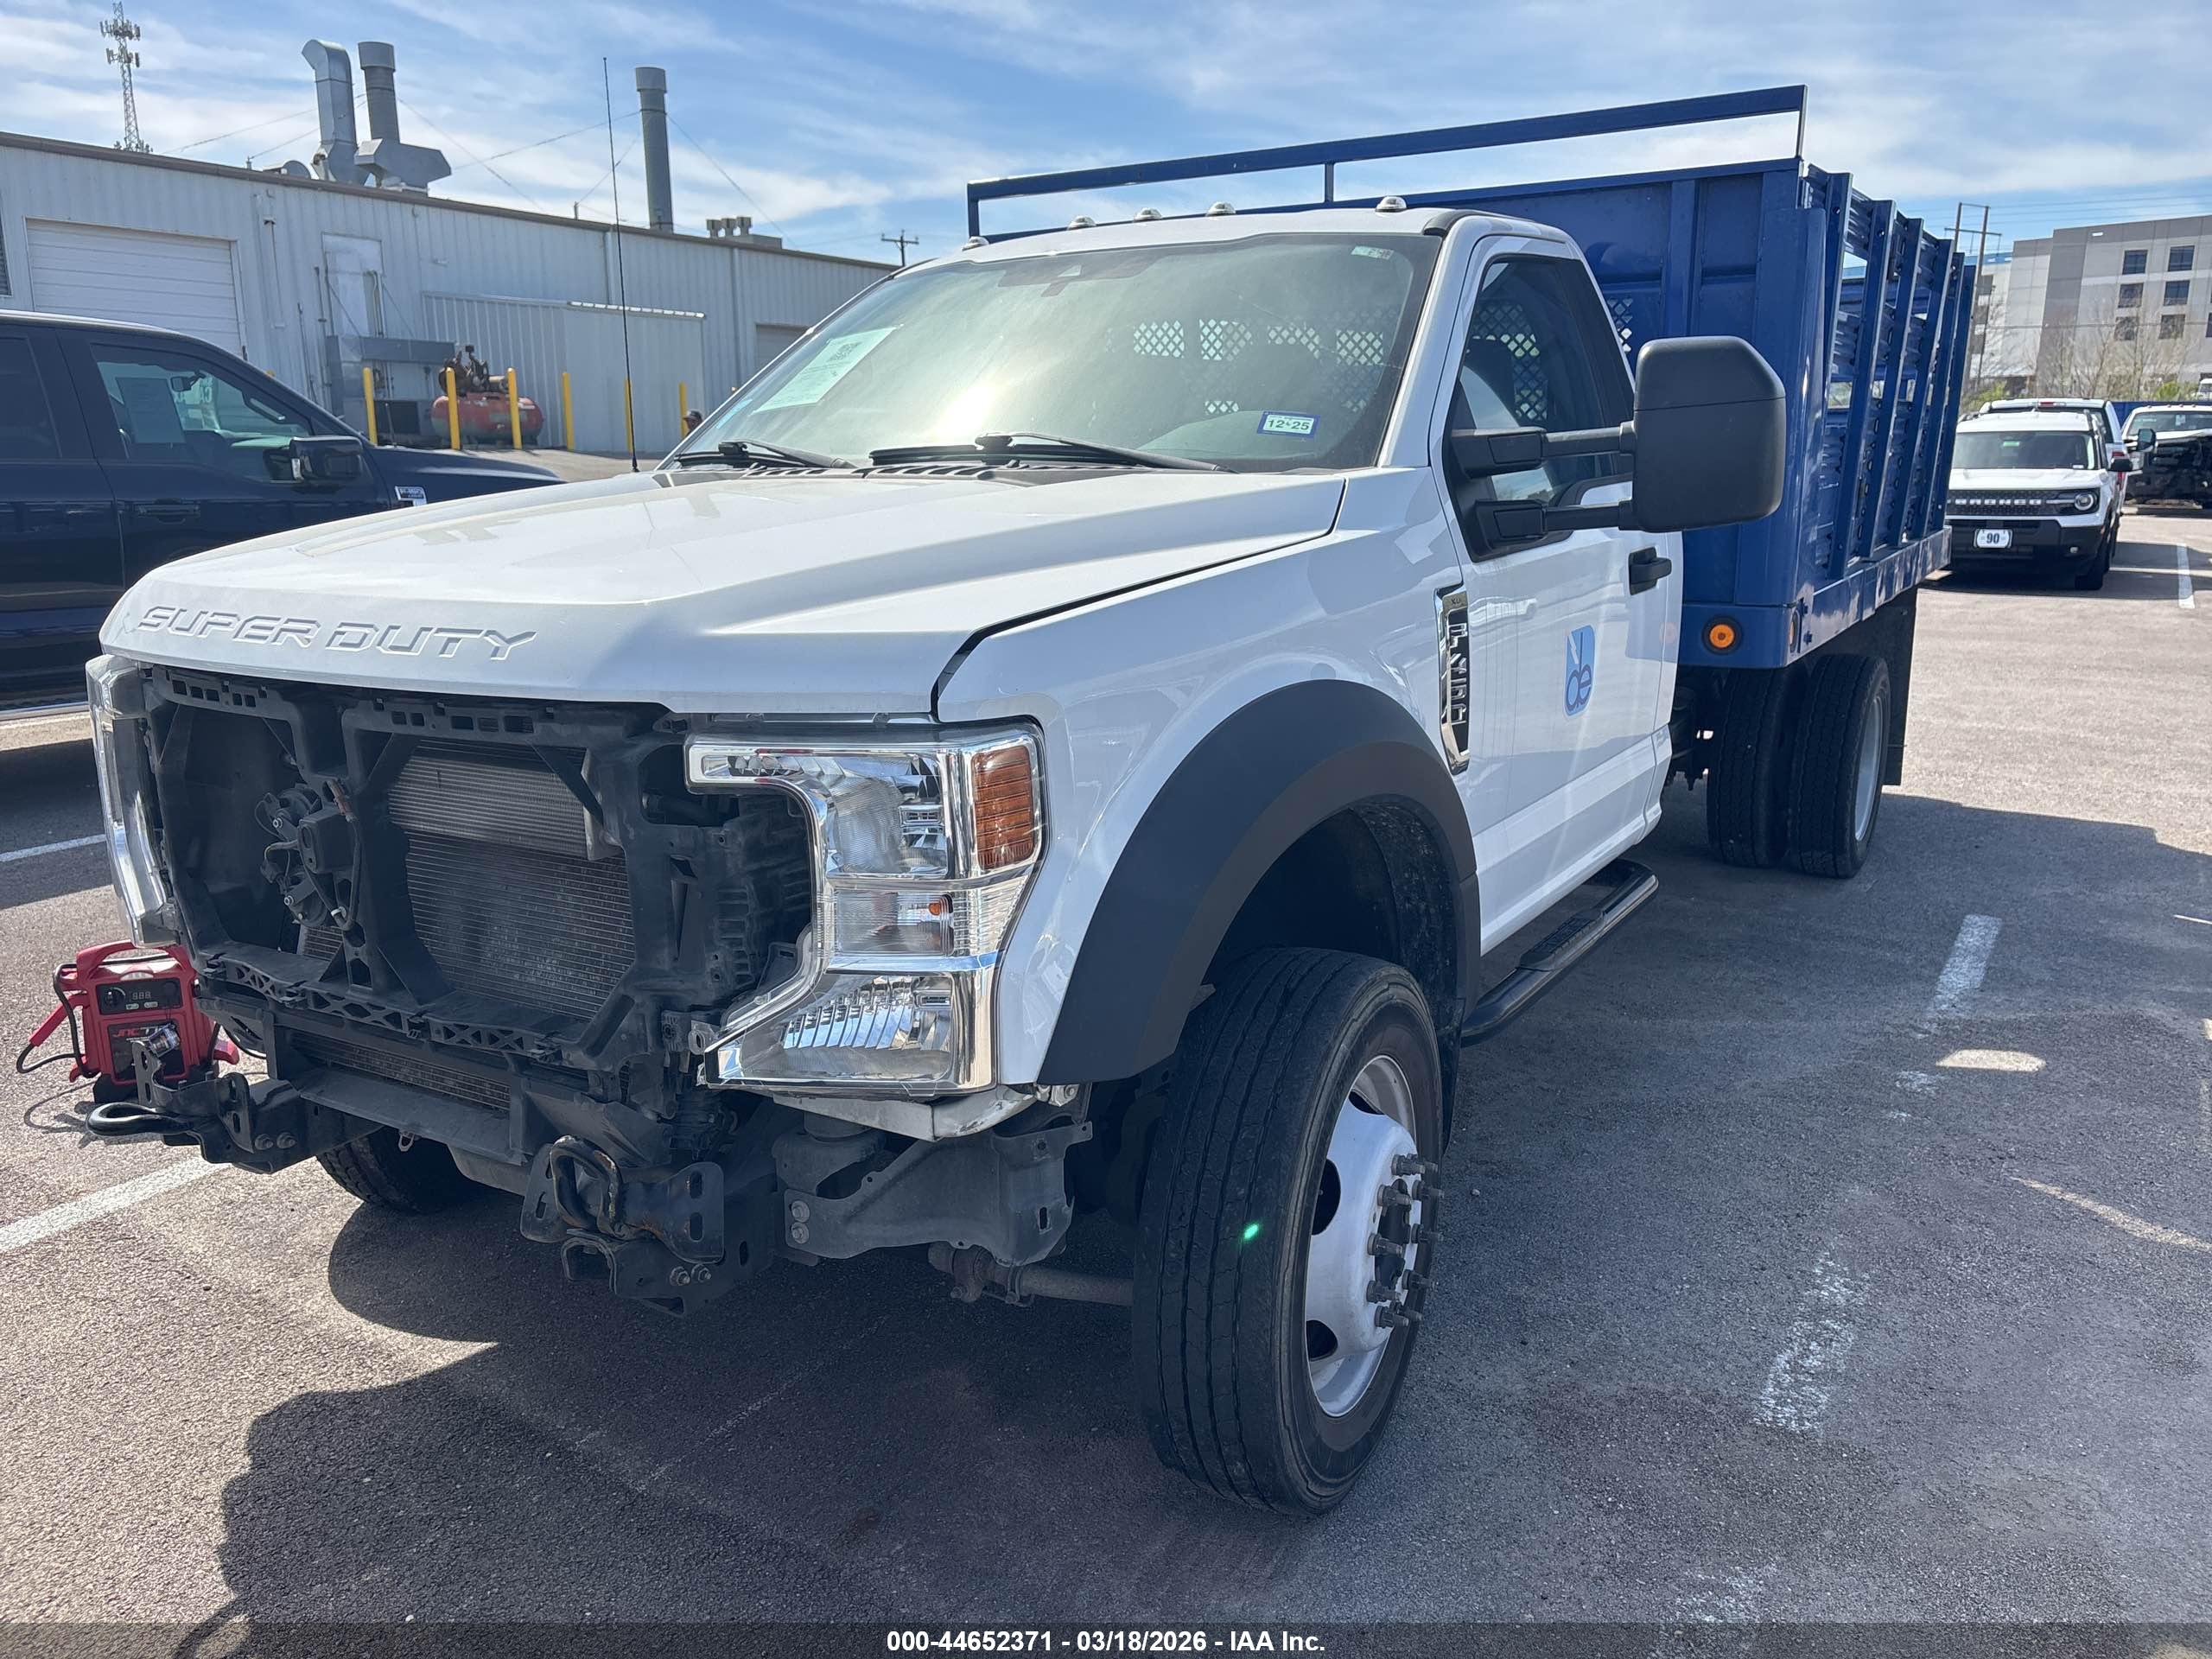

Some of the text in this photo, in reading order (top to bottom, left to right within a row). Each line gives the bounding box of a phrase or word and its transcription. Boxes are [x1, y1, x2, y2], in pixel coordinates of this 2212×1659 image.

[1268, 419, 1310, 430] 12 25
[1986, 532, 2000, 544] 90
[137, 605, 537, 661] SUPER DUTY
